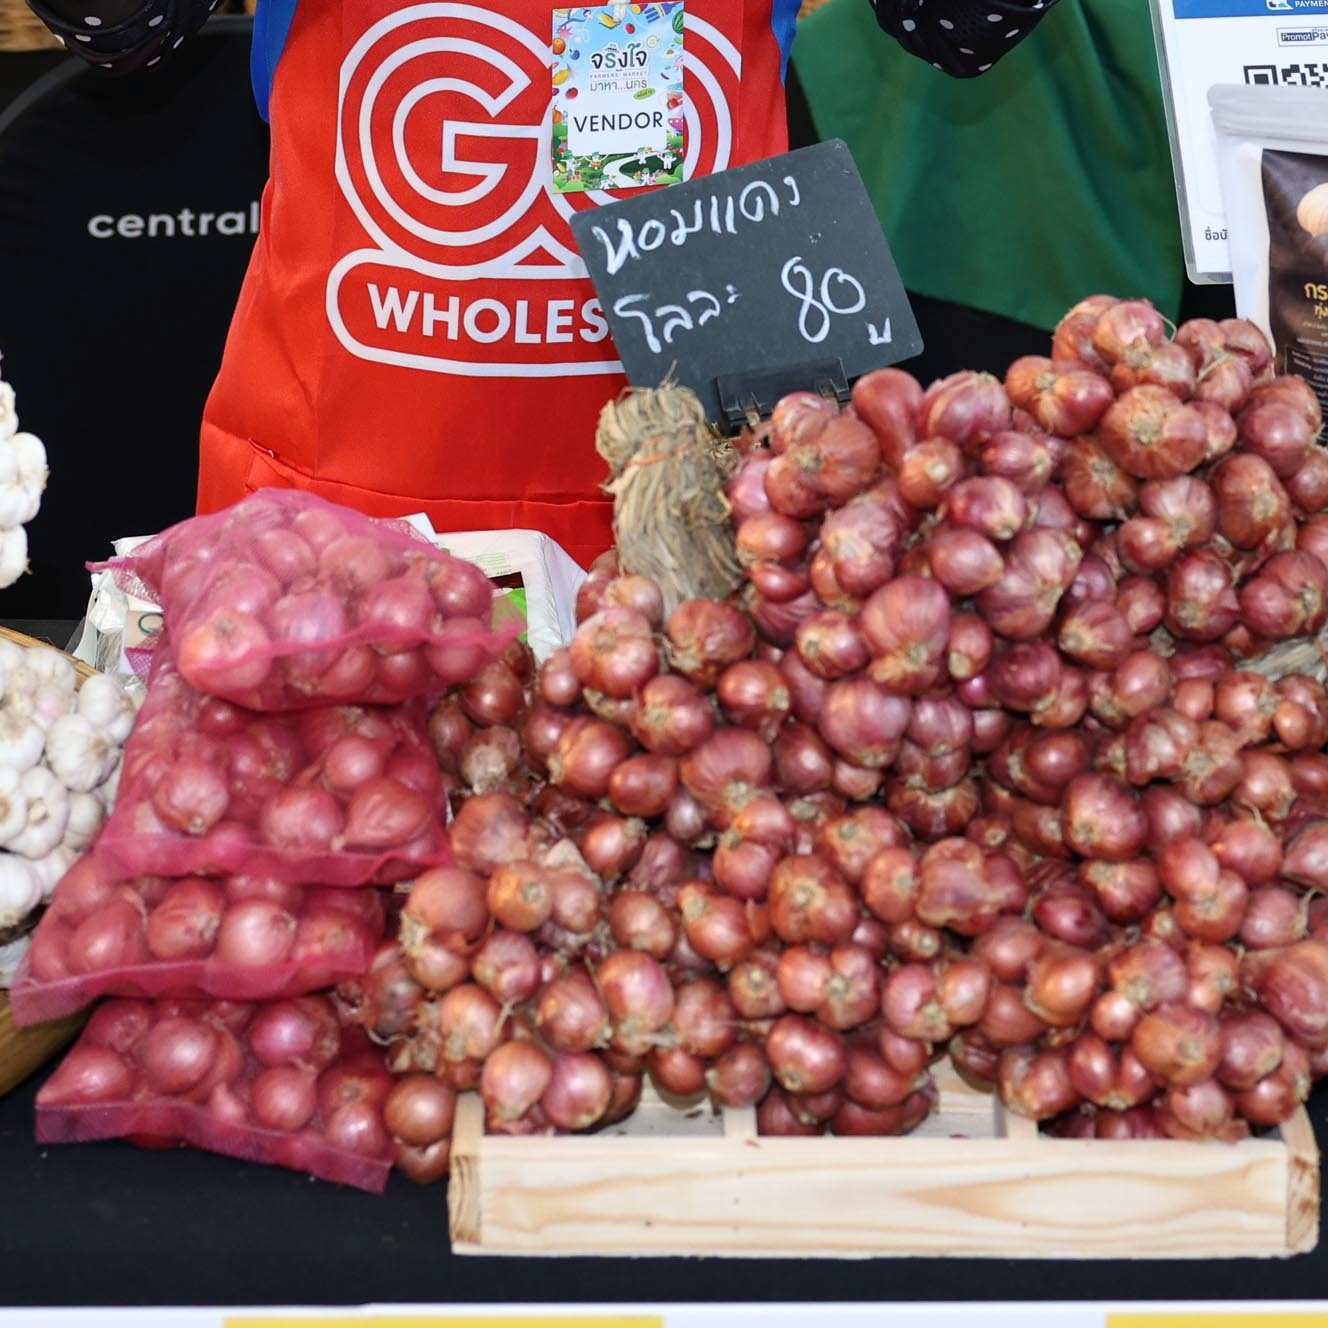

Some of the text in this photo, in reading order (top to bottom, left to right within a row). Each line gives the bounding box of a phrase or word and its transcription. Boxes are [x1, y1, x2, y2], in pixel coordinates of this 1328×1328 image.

[573, 111, 664, 133] VENDOR
[87, 201, 261, 239] central
[591, 175, 799, 275] หอมแดง
[1204, 226, 1228, 241] ชื่อบั
[366, 282, 615, 345] WHOLES
[780, 255, 866, 344] 80
